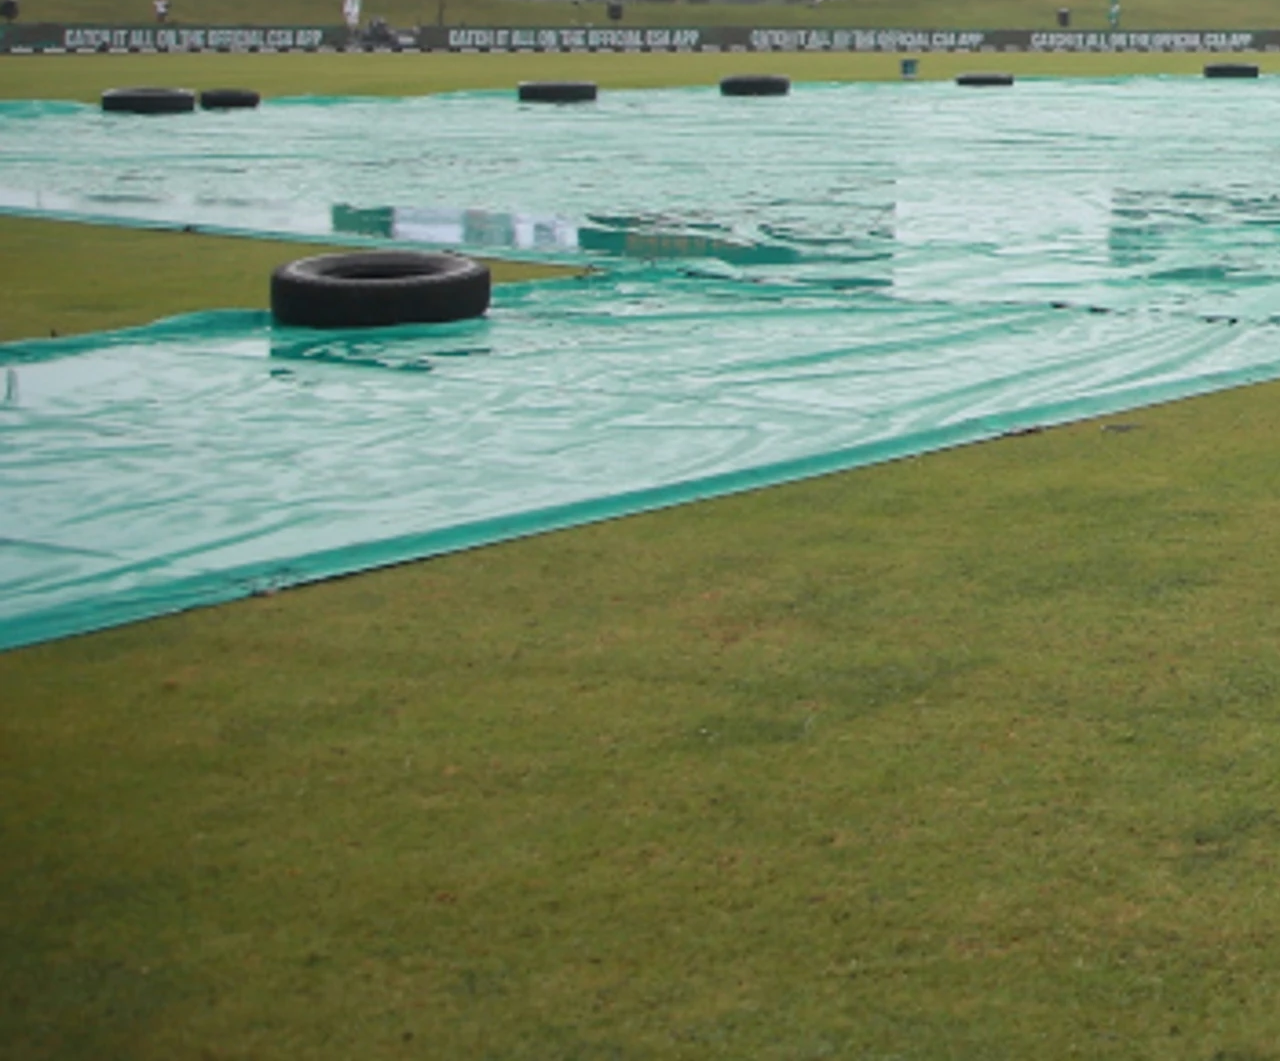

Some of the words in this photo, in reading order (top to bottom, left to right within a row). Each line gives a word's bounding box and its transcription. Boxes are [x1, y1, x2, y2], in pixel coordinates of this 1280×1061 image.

[65, 29, 110, 46] CATCH
[113, 29, 128, 46] IT
[130, 29, 153, 46] ALL
[157, 29, 177, 46] ON
[179, 29, 206, 46] THE
[208, 29, 264, 46] OFFICIAL
[449, 29, 494, 46] CATCH
[496, 29, 509, 46] IT
[511, 29, 535, 46] ALL
[537, 29, 557, 46] ON
[560, 29, 586, 46] THE
[588, 29, 642, 46] OFFICIAL
[673, 29, 699, 46] APP
